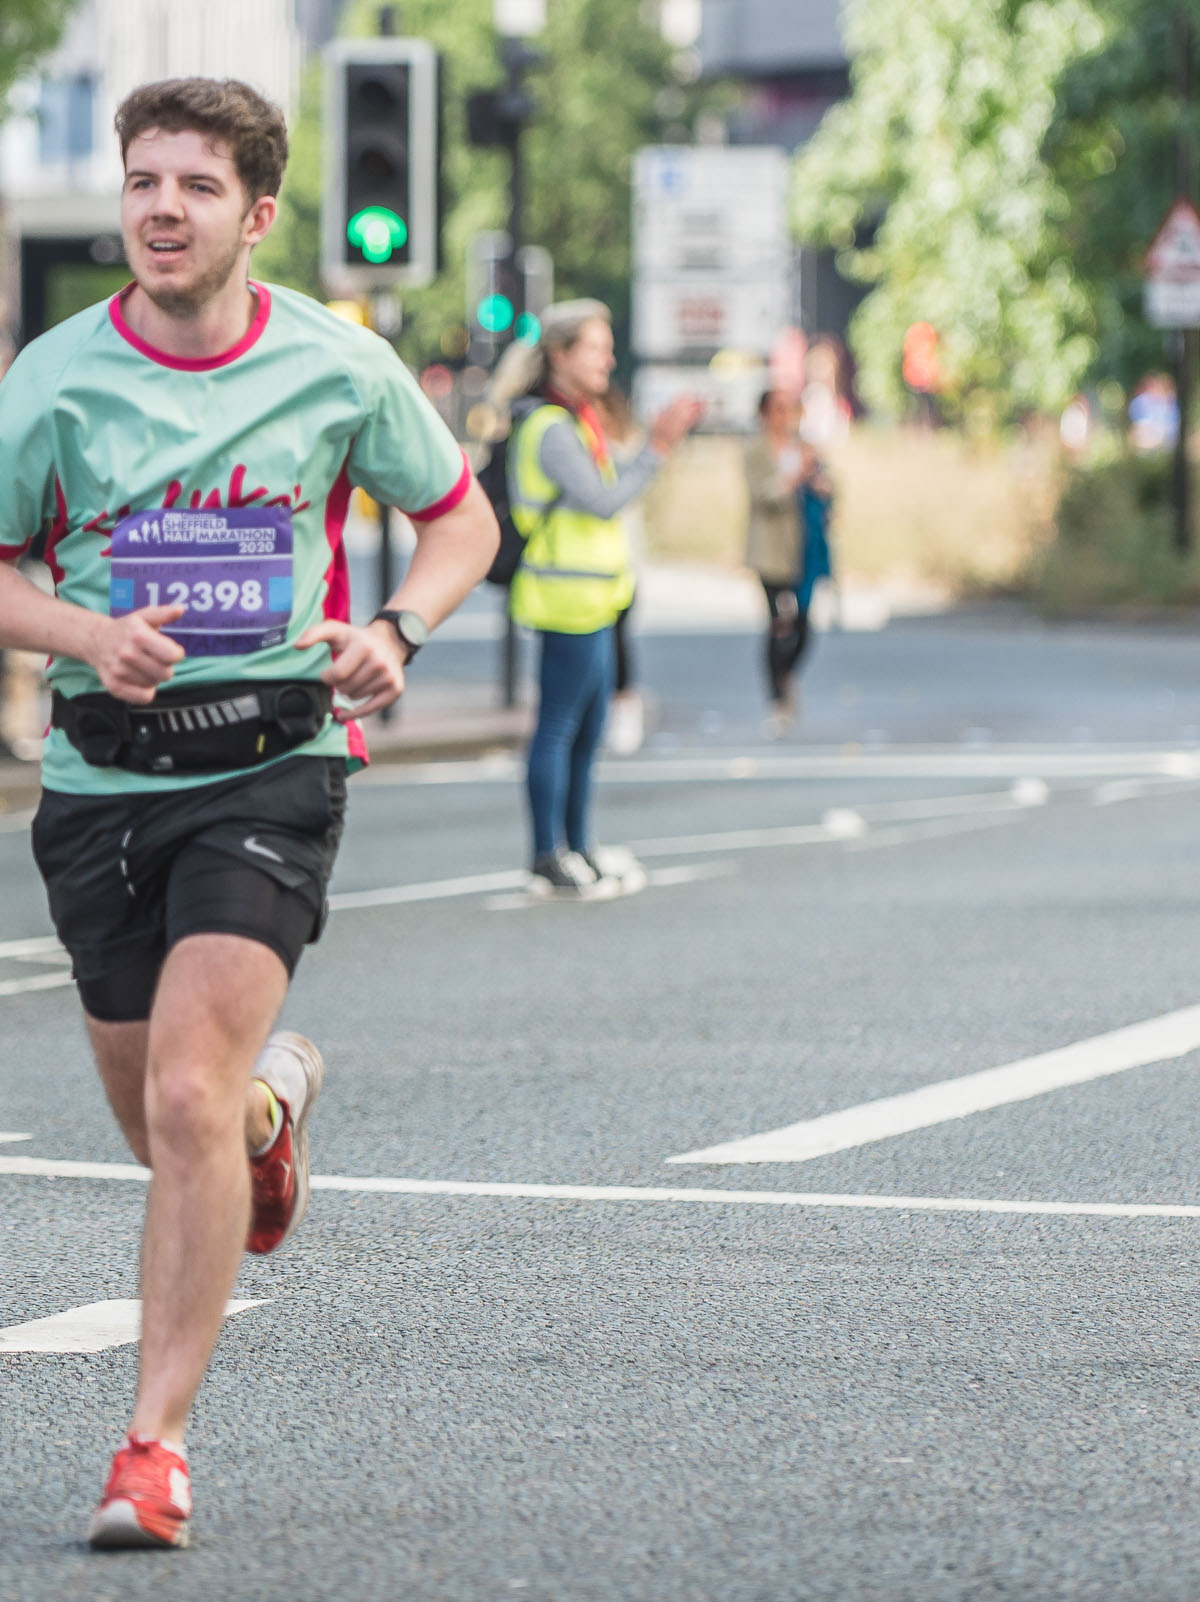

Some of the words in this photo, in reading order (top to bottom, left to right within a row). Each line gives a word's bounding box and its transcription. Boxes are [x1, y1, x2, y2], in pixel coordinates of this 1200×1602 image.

[164, 519, 224, 530] SHEFFIELD
[164, 530, 195, 542] HALF
[199, 529, 274, 541] MARATHON
[238, 542, 275, 554] 2020
[145, 580, 263, 612] 12398
